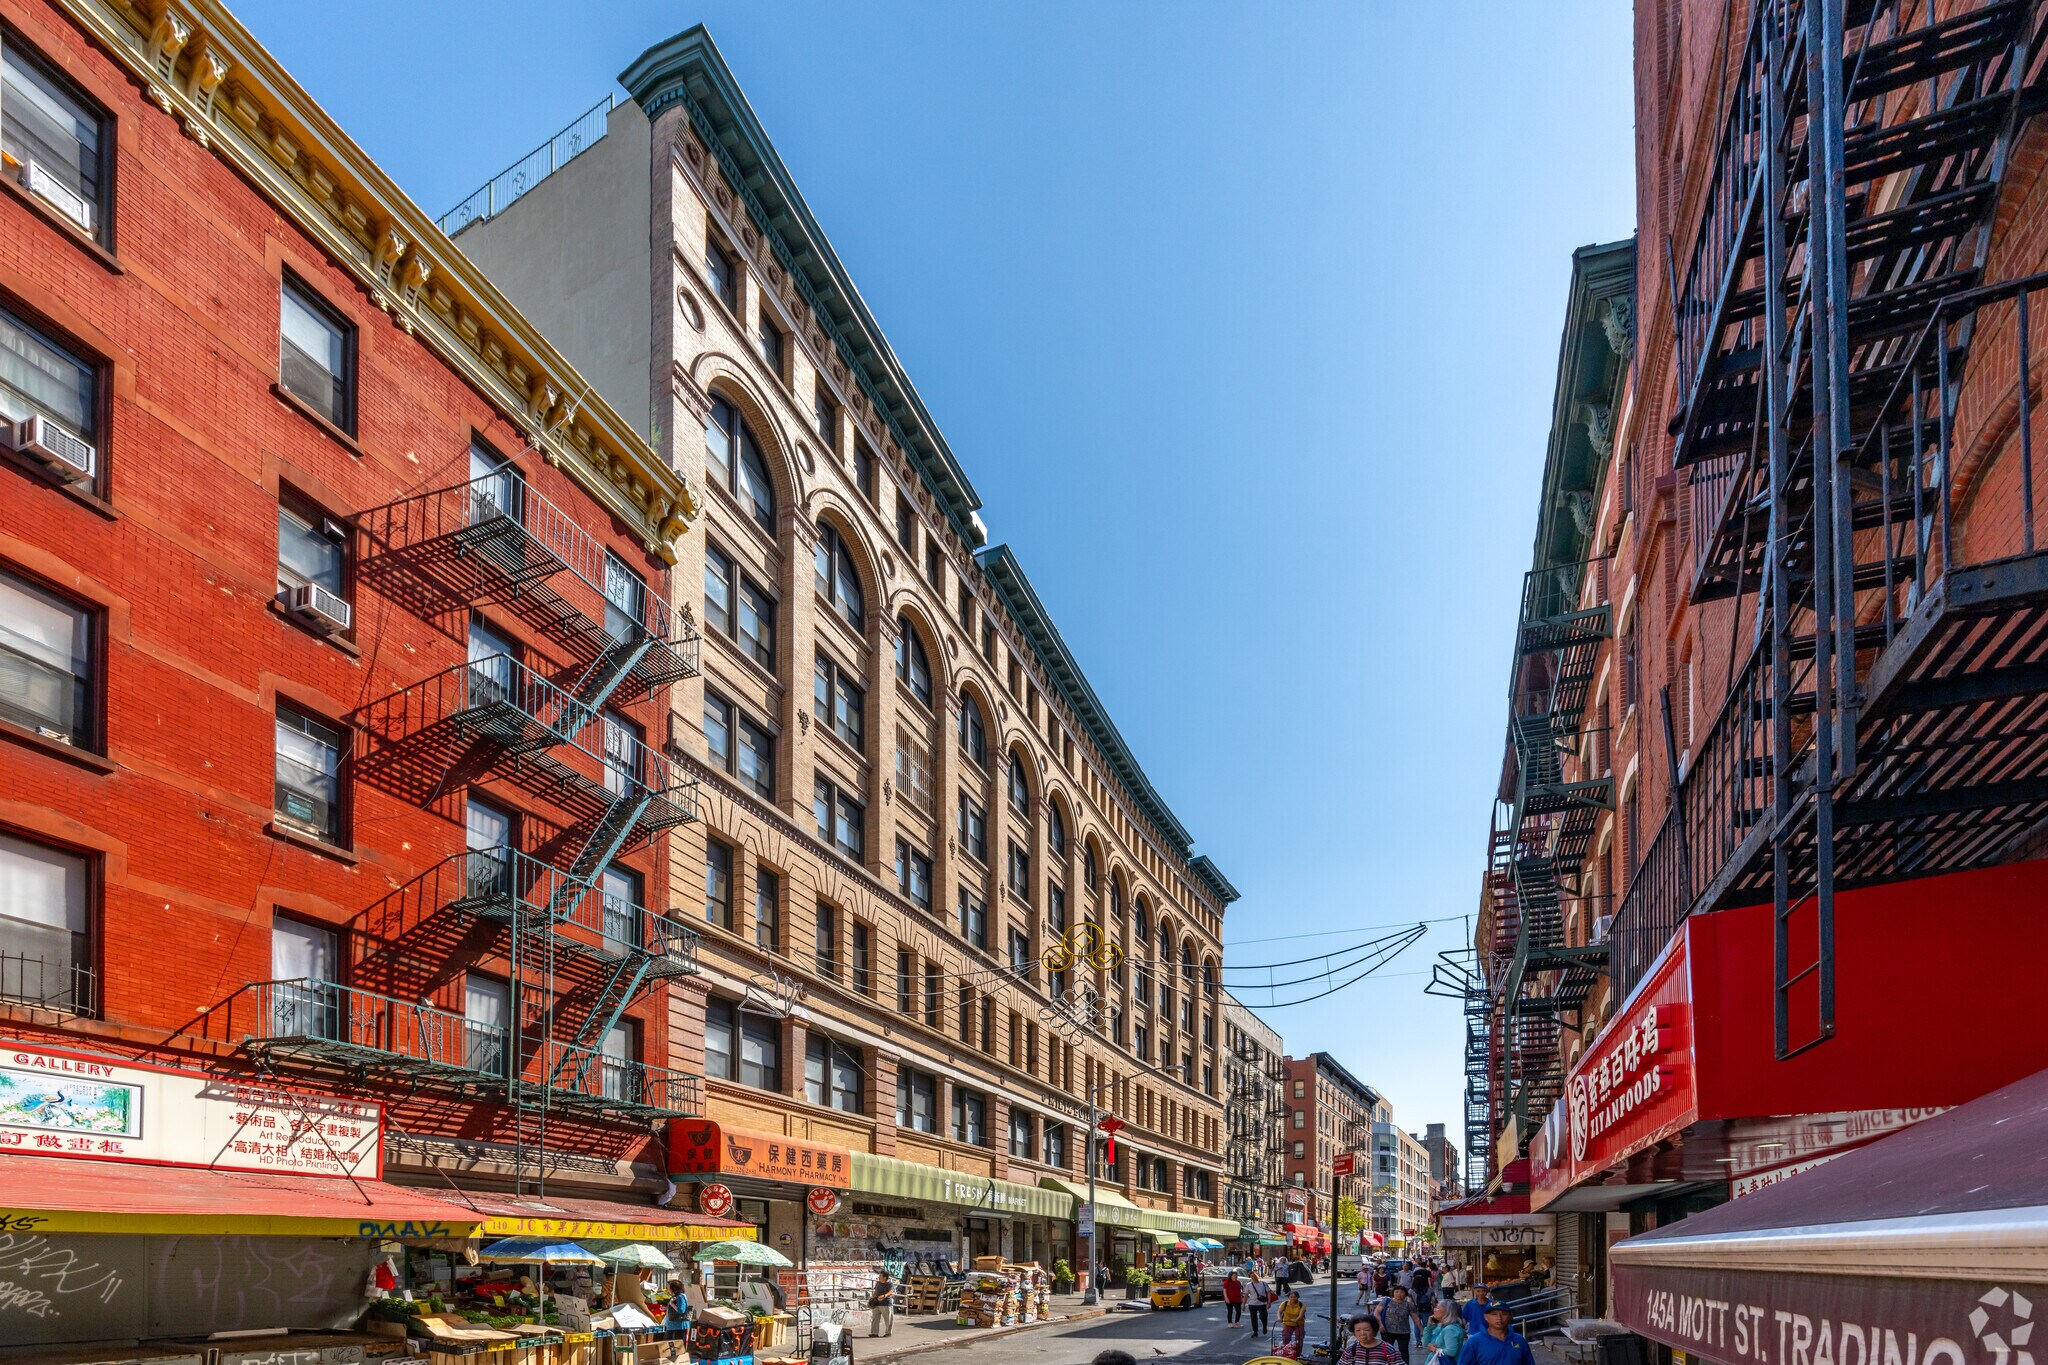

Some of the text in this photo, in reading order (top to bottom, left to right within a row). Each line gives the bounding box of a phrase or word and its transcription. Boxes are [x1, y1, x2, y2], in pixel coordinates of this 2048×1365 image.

[14, 1053, 114, 1077] GALLERY
[1588, 1004, 1659, 1112] 紫燕百味鸡
[236, 1101, 290, 1116] Advertising
[333, 1112, 362, 1125] Design
[1590, 1064, 1661, 1140] ZIYANFOODS
[259, 1130, 273, 1140] Art
[259, 1155, 339, 1171] HD Photo Printing
[768, 1143, 842, 1173] 保健西藥房
[758, 1162, 797, 1177] HARMONY
[799, 1168, 837, 1183] PHARMACY
[955, 1183, 983, 1200] FRESH
[492, 1221, 507, 1230] 140
[517, 1219, 536, 1231] JC
[625, 1225, 639, 1236] JC
[640, 1225, 671, 1237] FRUIT
[674, 1227, 681, 1238] &
[684, 1227, 735, 1239] VEGETABLE
[737, 1229, 749, 1239] CO.
[1647, 1289, 1675, 1333] 145A
[1678, 1294, 1729, 1348] MOTT
[1734, 1303, 1767, 1362] ST.
